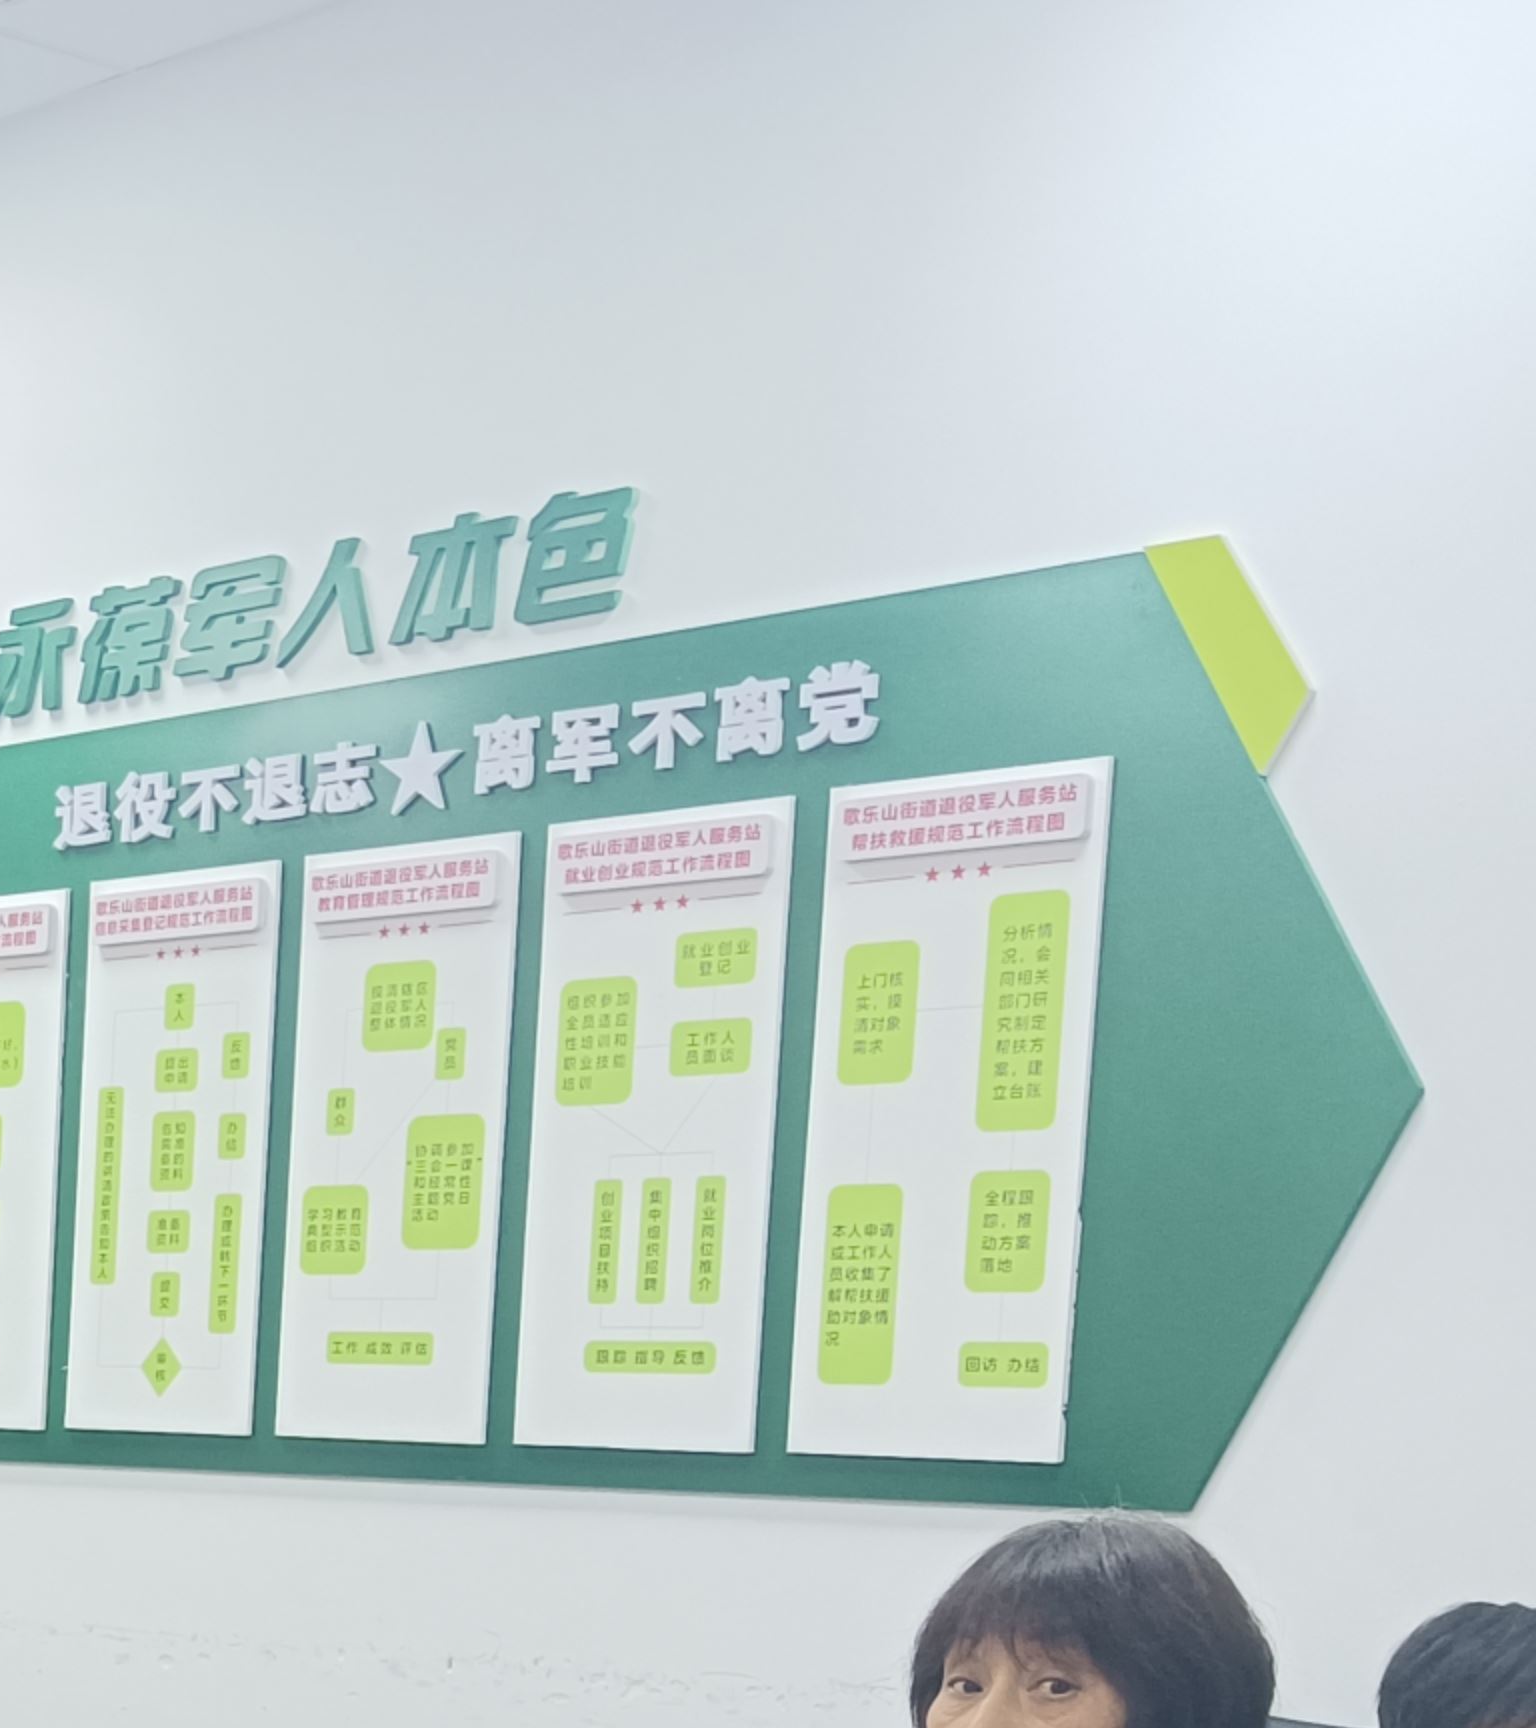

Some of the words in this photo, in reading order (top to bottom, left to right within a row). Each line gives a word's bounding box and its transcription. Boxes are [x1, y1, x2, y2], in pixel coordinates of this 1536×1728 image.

[52, 740, 382, 852] 退役不退志
[471, 659, 883, 796] 离军不离党
[843, 784, 1077, 826] 歌乐山街道退役军人服务站
[558, 823, 761, 860] 歌乐山街道退役军人服务站
[851, 812, 1065, 852] 帮扶救援规范工作流程图
[311, 859, 488, 892] 歌乐山街道退役军人服务站
[564, 850, 750, 885] 就业创业规范工作流程图
[317, 881, 480, 912] 教育管理规范工作流程图
